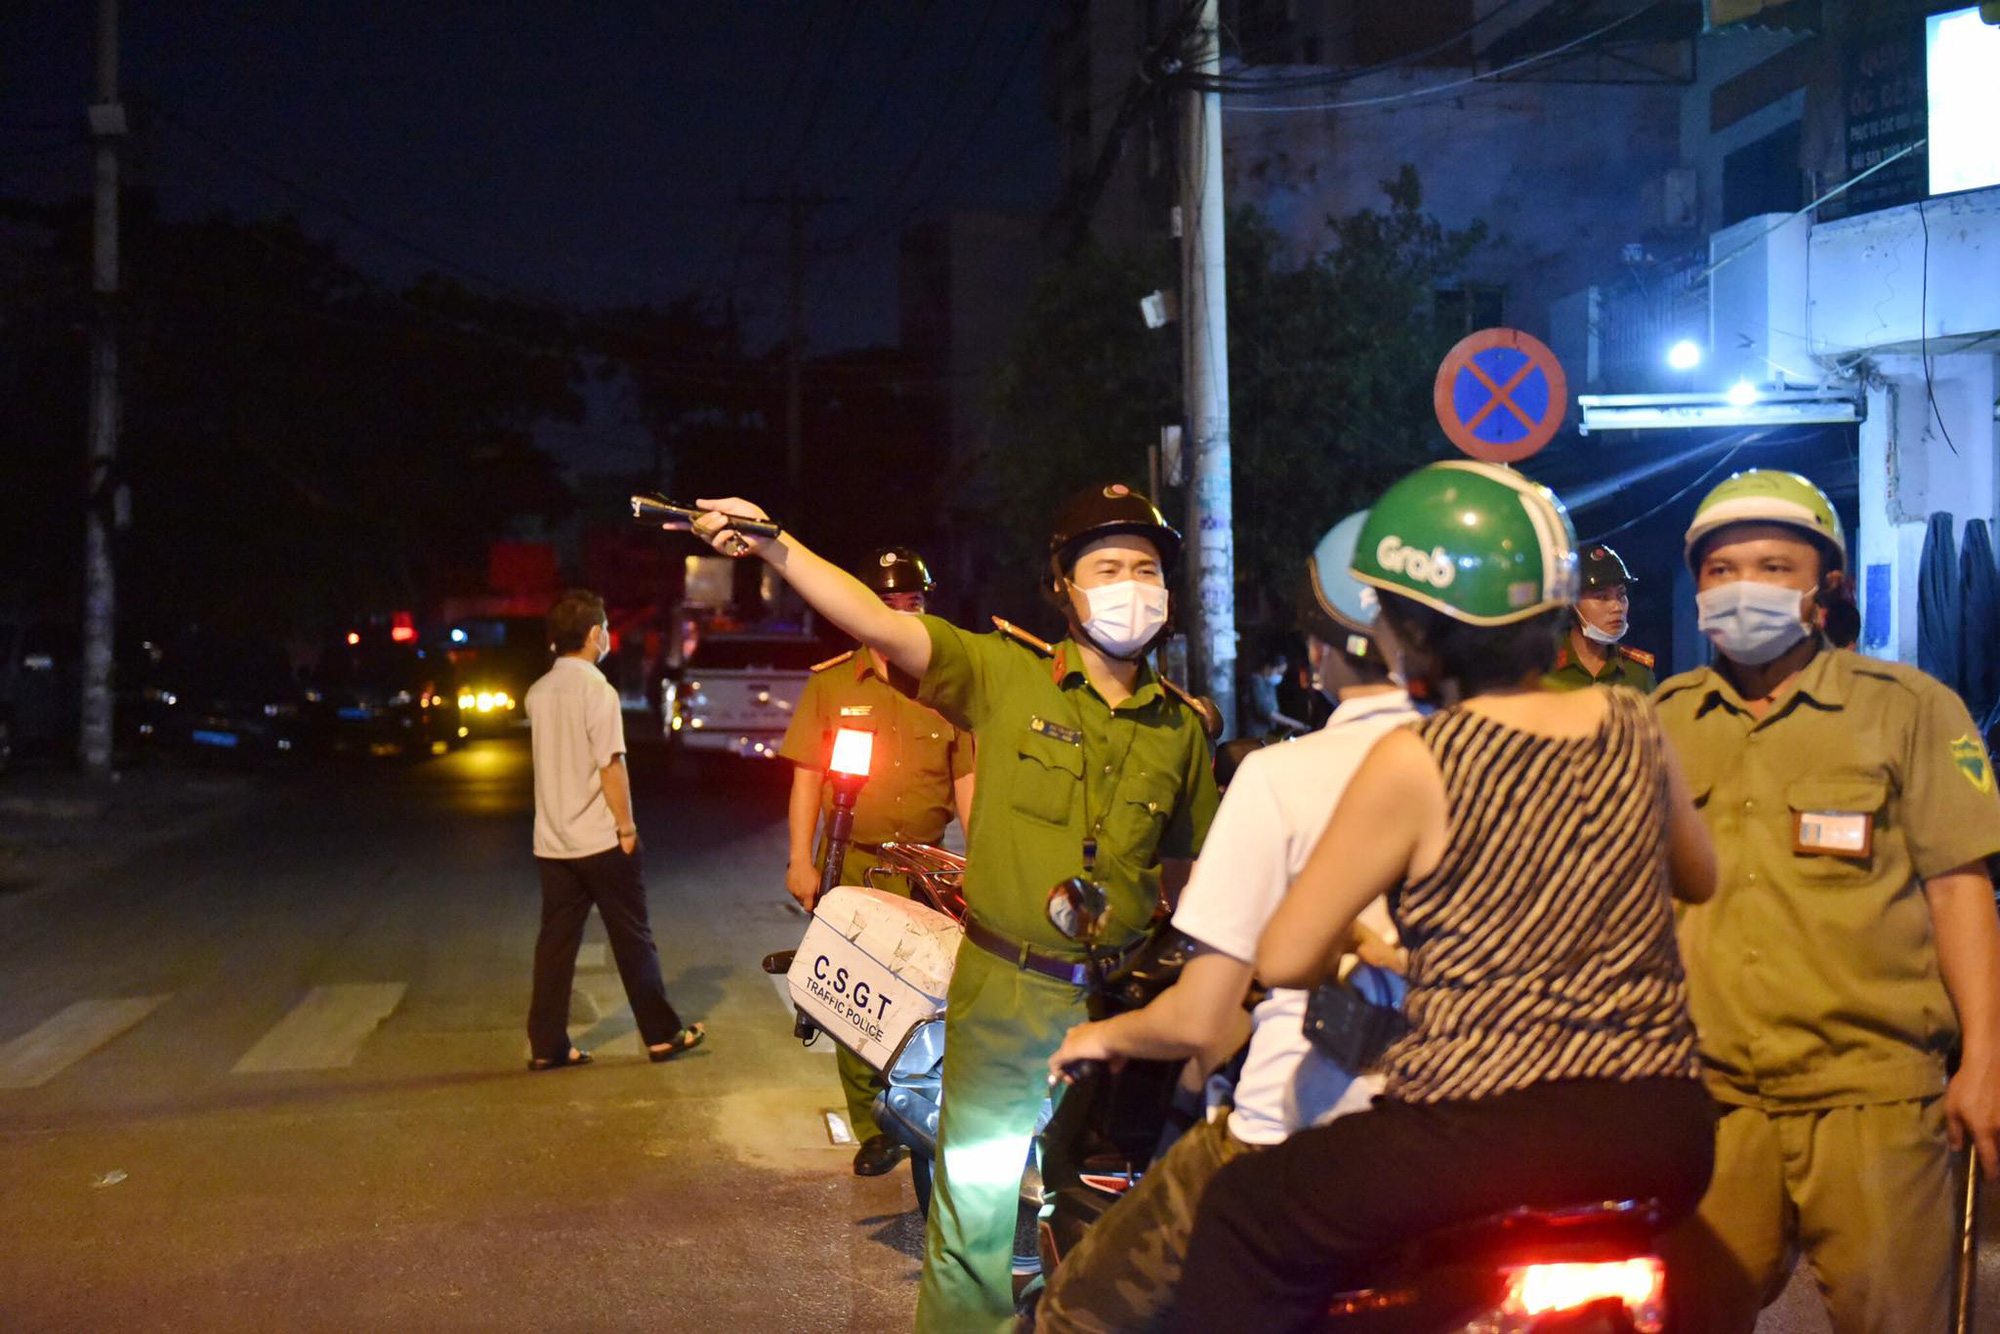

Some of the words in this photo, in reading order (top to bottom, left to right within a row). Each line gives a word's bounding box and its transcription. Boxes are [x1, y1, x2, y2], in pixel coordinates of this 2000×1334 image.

[1376, 535, 1456, 589] Grab
[806, 977, 845, 1014] TRAFFIC
[845, 1008, 884, 1043] POLICE
[814, 955, 892, 1021] C.S.G.T
